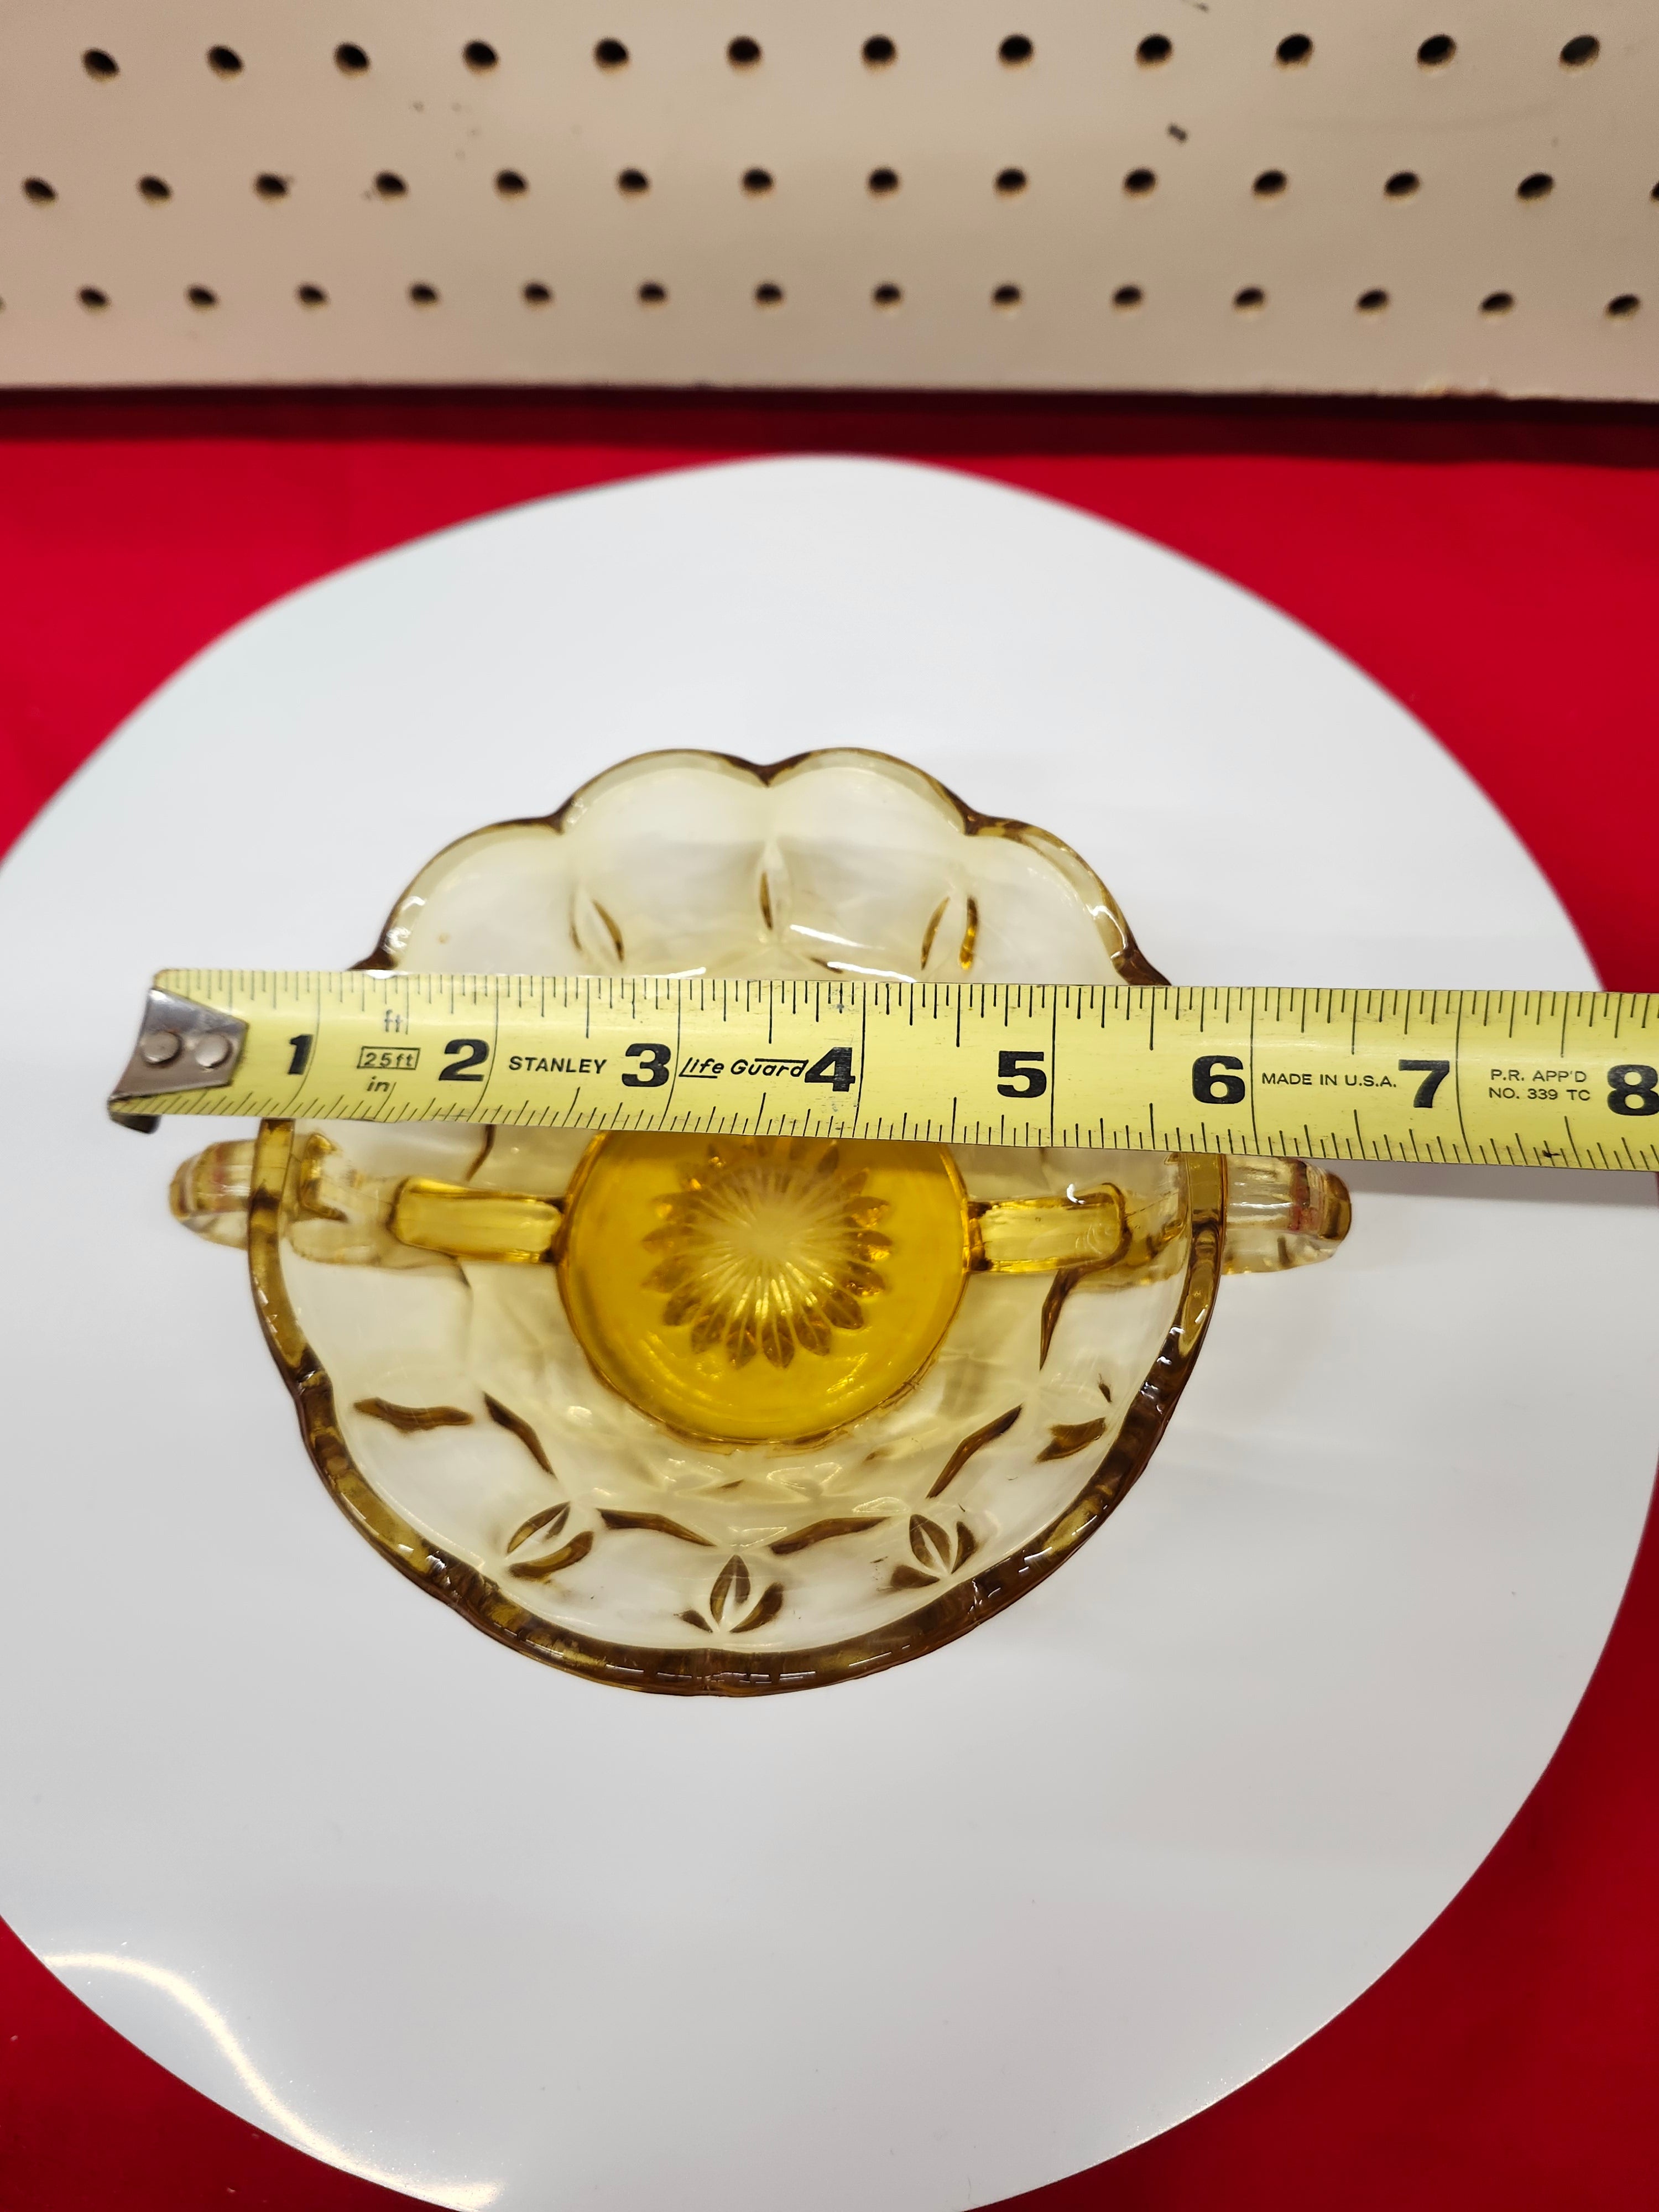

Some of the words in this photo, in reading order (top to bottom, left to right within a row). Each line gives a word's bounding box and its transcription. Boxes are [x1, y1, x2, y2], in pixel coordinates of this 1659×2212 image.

[384, 1010, 404, 1032] ft
[287, 1034, 314, 1076] 1
[363, 1051, 415, 1068] 25ft
[438, 1038, 490, 1082] 2
[508, 1055, 608, 1075] STANLEY
[622, 1042, 672, 1088] 3
[679, 1056, 724, 1079] Life
[730, 1057, 810, 1078] Guard
[804, 1046, 856, 1093] 4
[366, 1076, 390, 1093] in
[997, 1050, 1047, 1098] 5
[1192, 1055, 1245, 1105] 6
[1261, 1072, 1313, 1087] MADE
[1319, 1073, 1338, 1087] IN
[1344, 1074, 1397, 1088] U.S.A.
[1398, 1059, 1450, 1109] 7
[1490, 1068, 1525, 1082] P.R.
[1532, 1069, 1587, 1084] APP'D
[1488, 1086, 1521, 1100] NO.
[1527, 1087, 1558, 1101] 339
[1567, 1088, 1591, 1102] TC
[1606, 1064, 1659, 1117] 8
